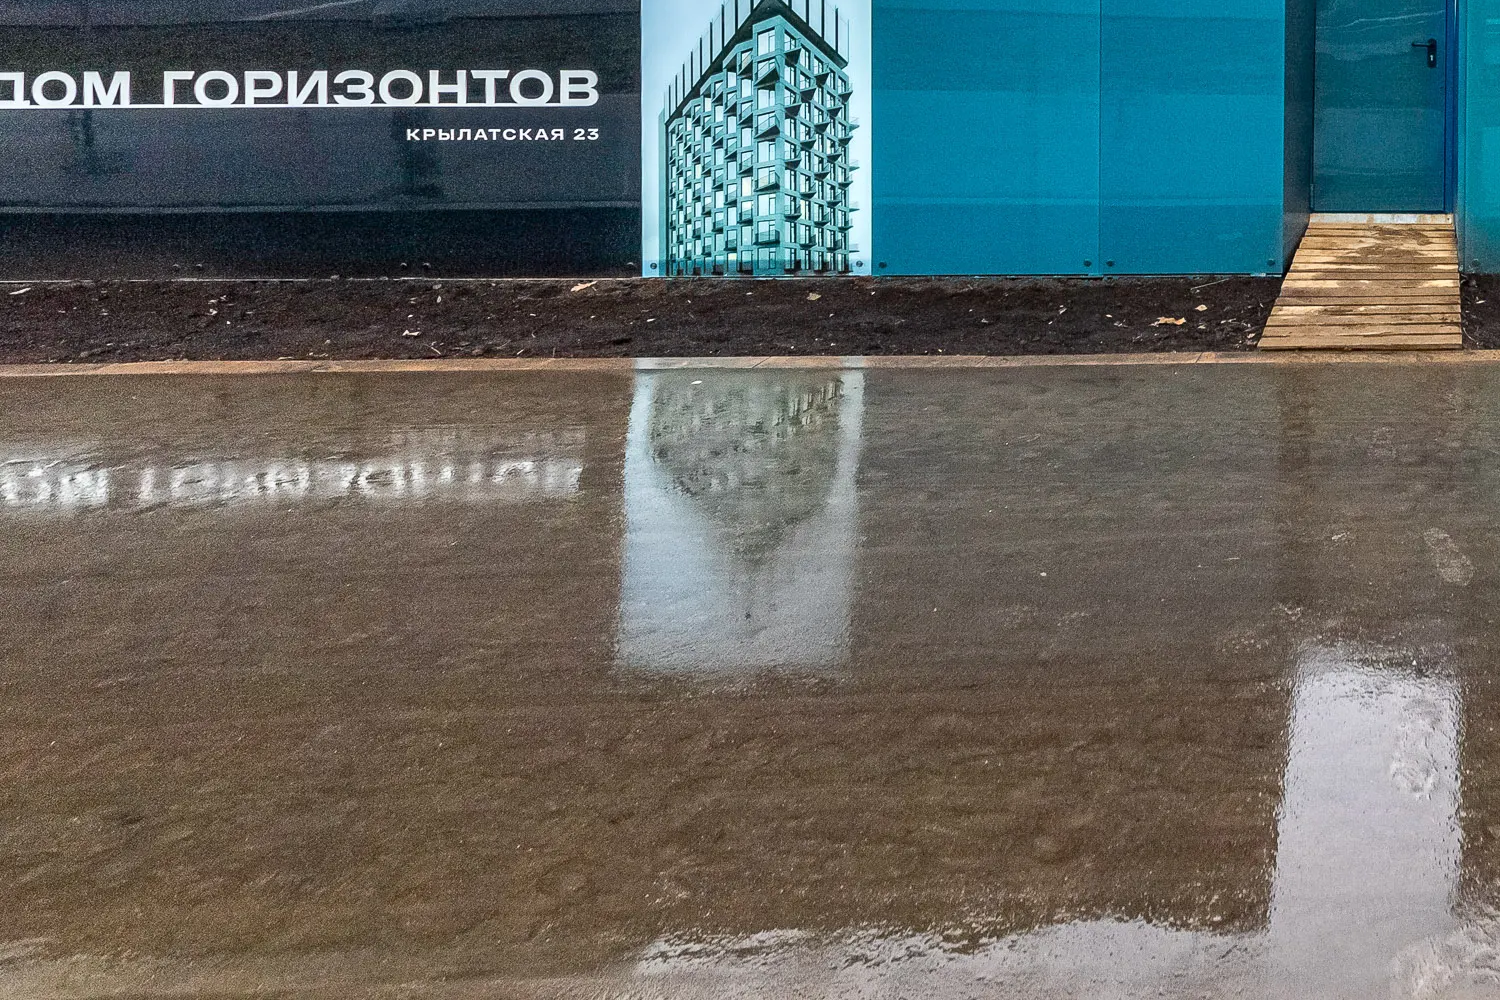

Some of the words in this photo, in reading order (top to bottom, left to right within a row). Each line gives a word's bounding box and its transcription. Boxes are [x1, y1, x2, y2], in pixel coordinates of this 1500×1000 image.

[0, 70, 132, 108] ДОМ
[162, 69, 600, 108] ГОРИЗОНТОВ
[405, 127, 565, 142] КРЫЛАТСКАЯ
[572, 127, 600, 142] 23
